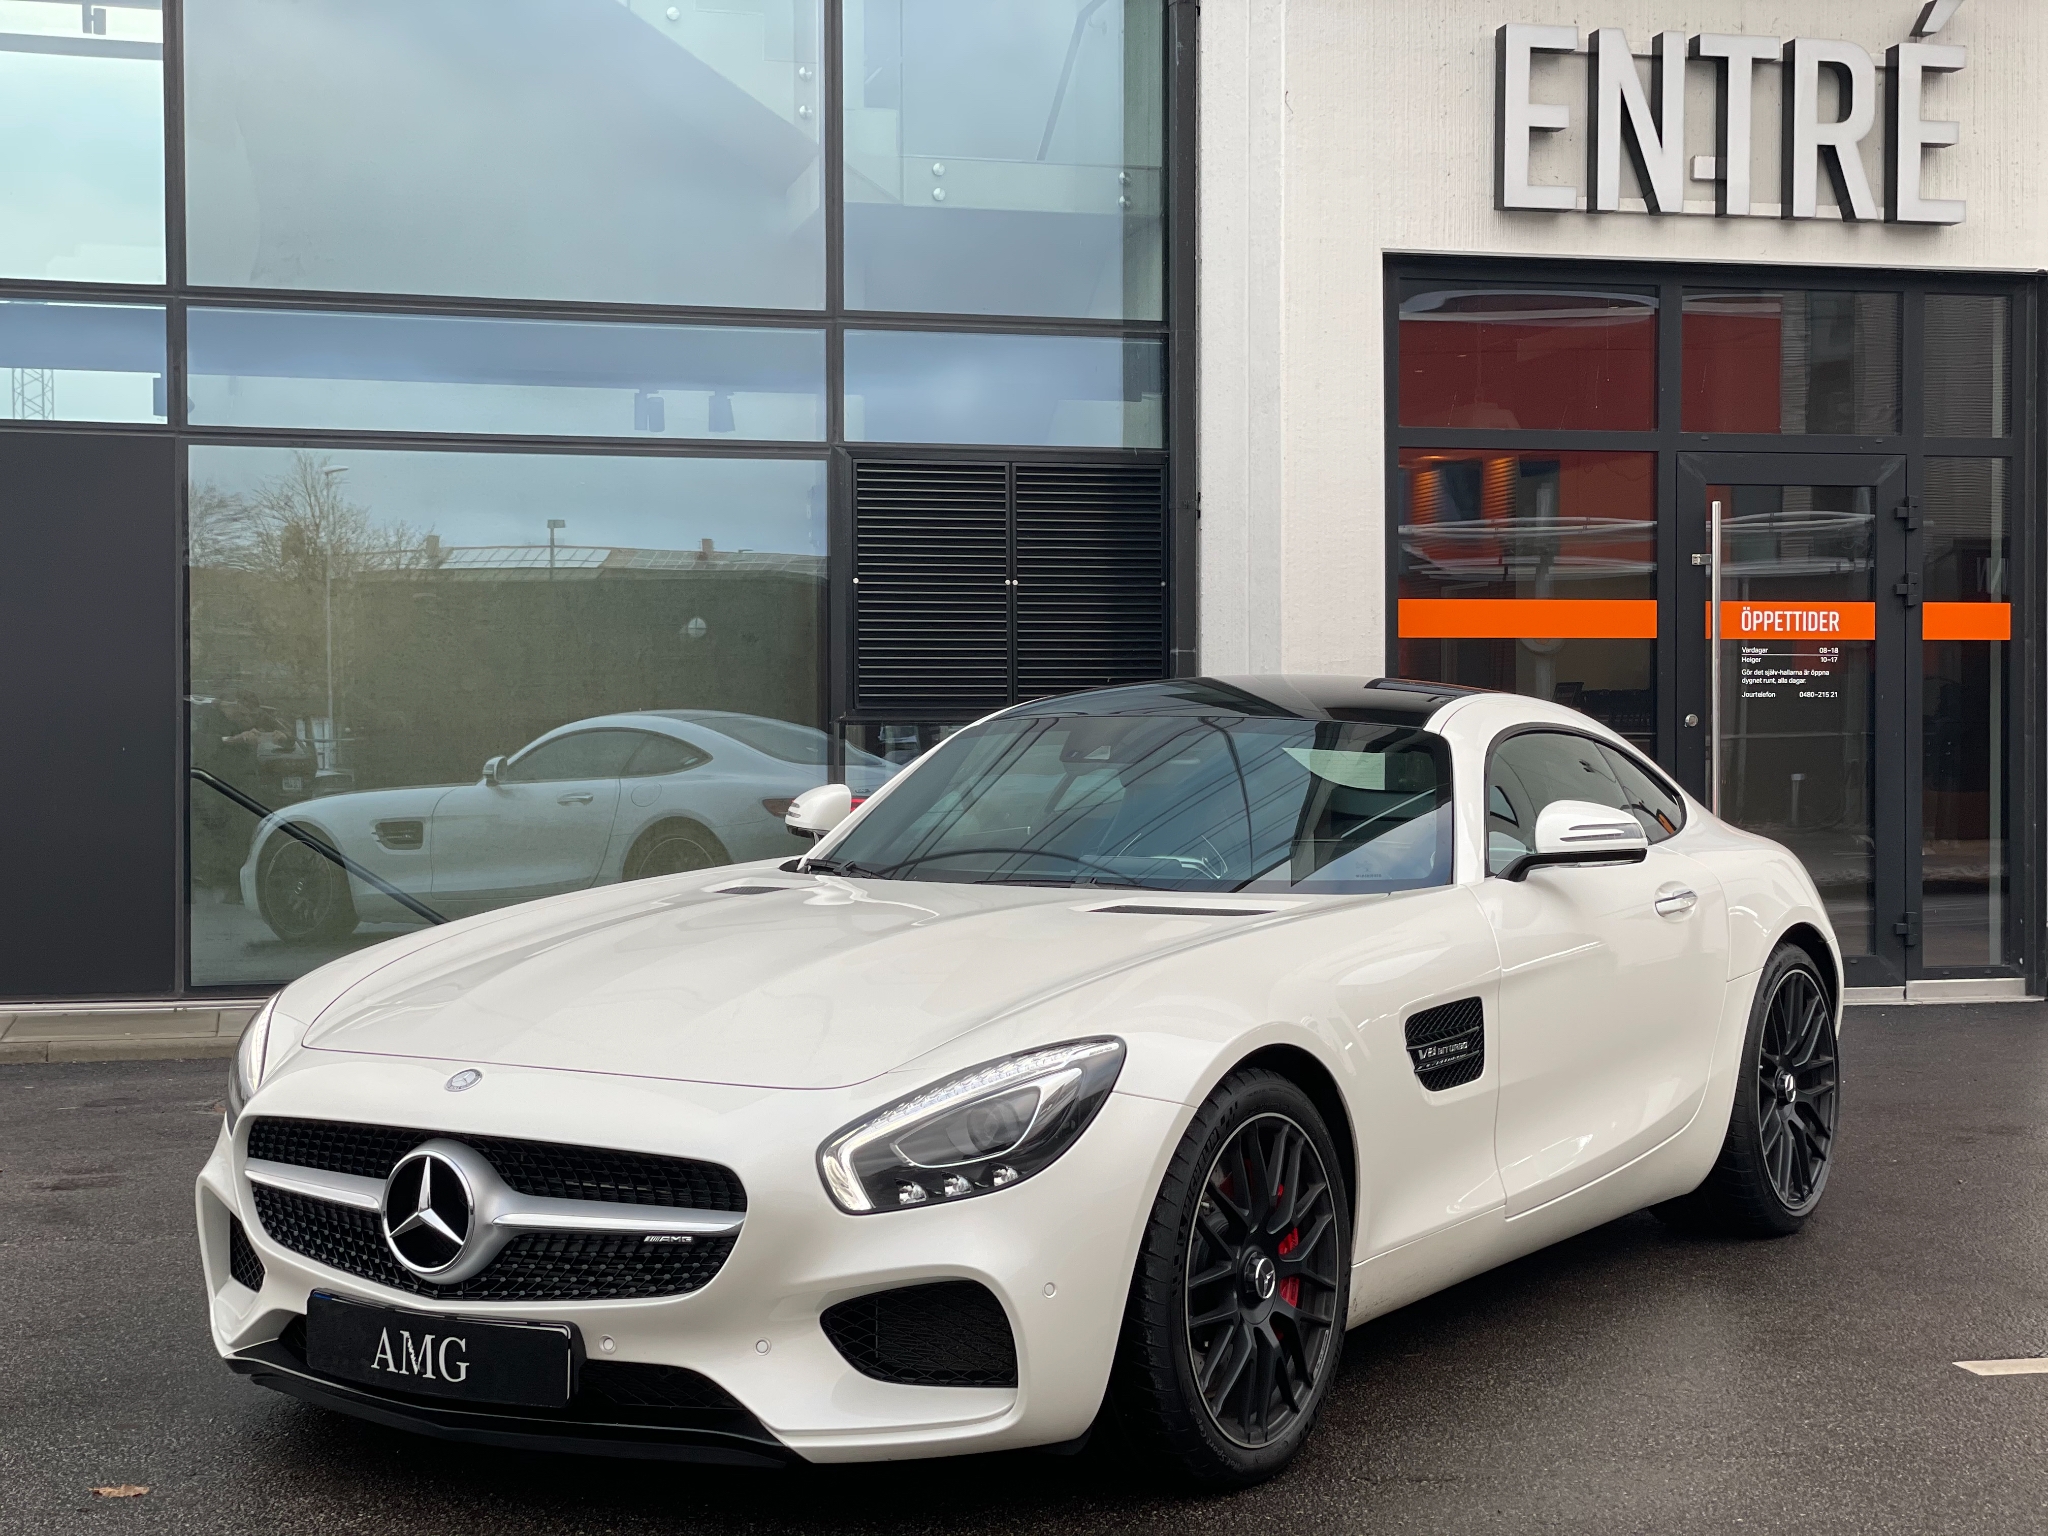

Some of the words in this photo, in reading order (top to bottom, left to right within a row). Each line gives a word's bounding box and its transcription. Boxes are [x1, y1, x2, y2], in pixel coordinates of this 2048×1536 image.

[1495, 0, 1967, 226] ENTRÉ
[1741, 606, 1840, 632] ÖPPETTIDER
[1764, 669, 1802, 677] själv-hallarna
[1810, 669, 1830, 677] öppna
[657, 1235, 692, 1243] AMG
[370, 1326, 470, 1383] AMG
